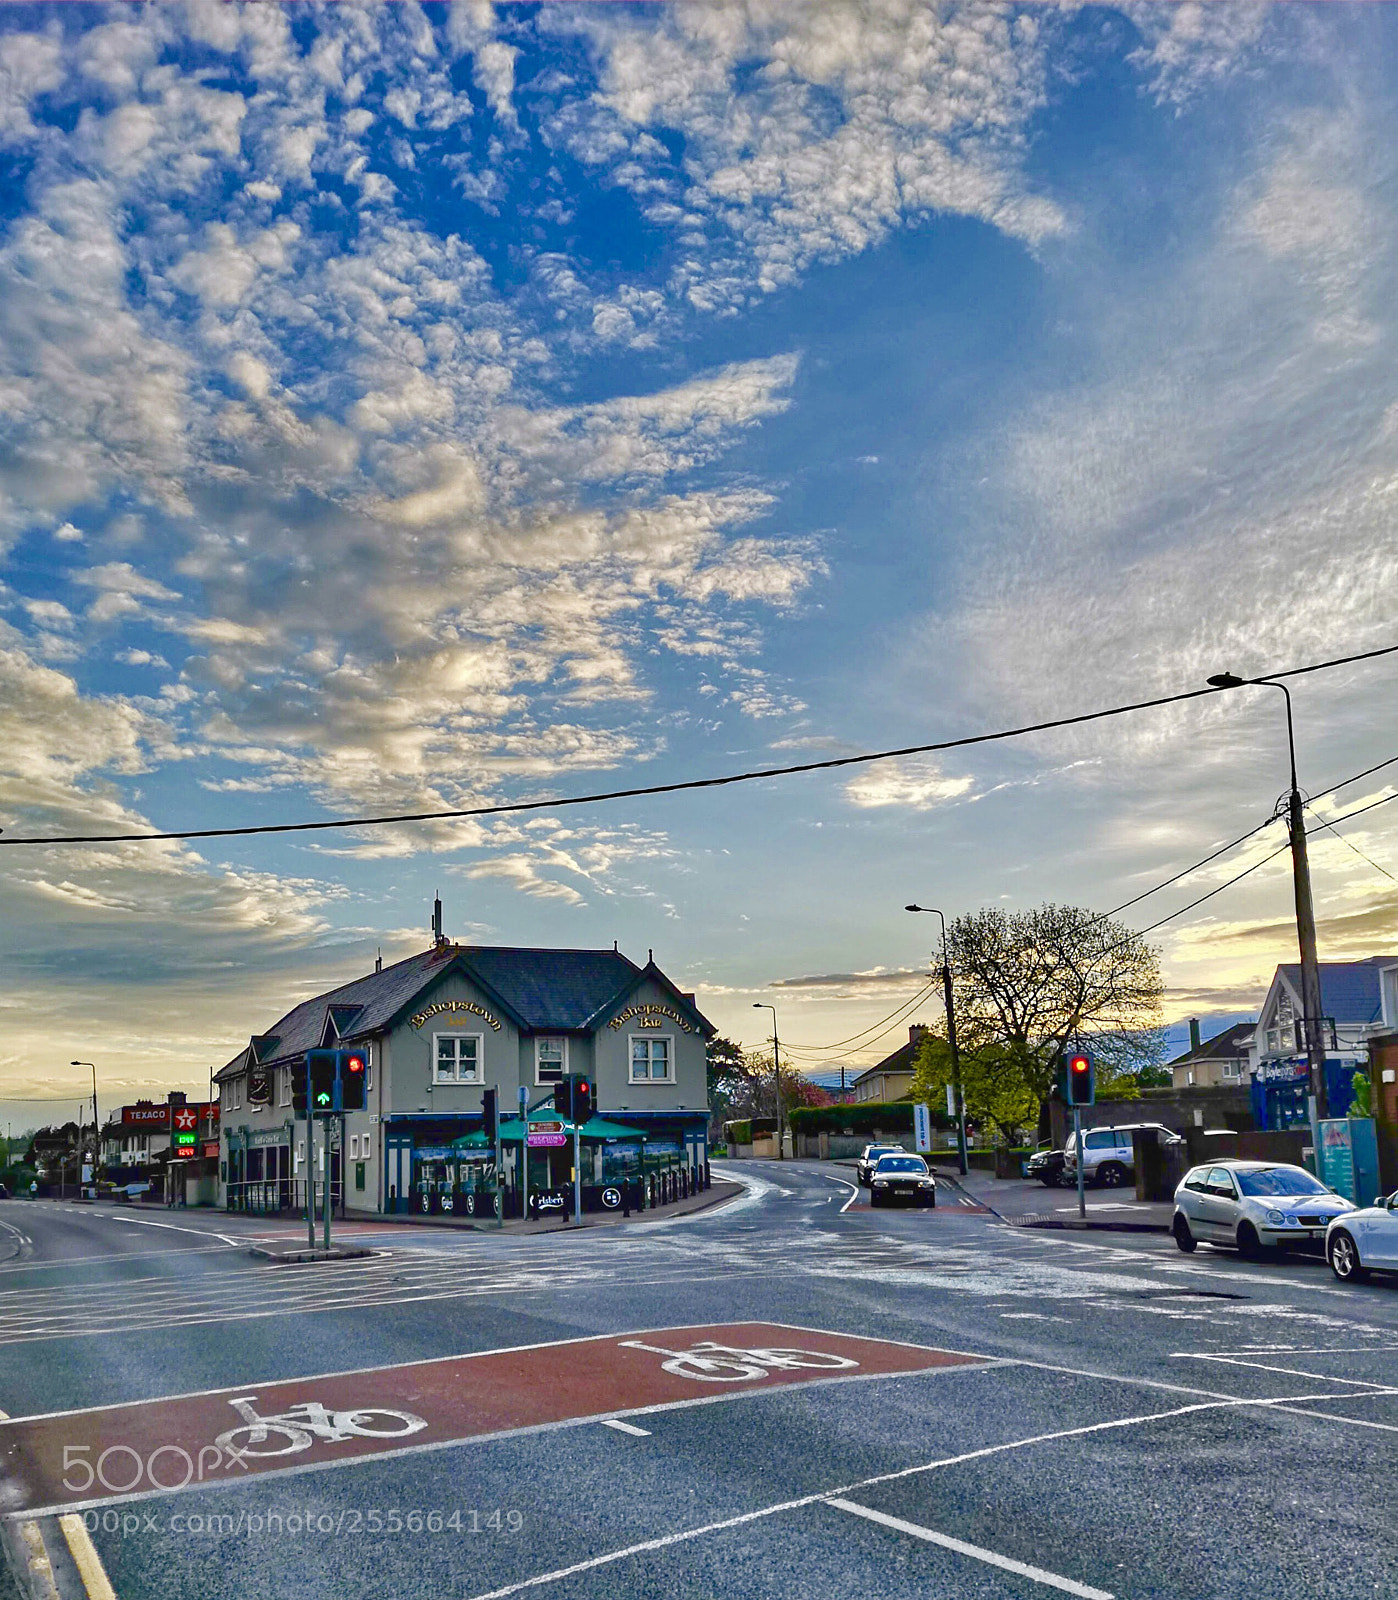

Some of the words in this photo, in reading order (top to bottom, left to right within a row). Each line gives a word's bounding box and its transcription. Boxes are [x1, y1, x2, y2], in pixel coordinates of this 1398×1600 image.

[410, 1001, 502, 1033] Bishopstown
[608, 1004, 692, 1033] Bishopstown
[131, 1110, 165, 1120] TEXACO
